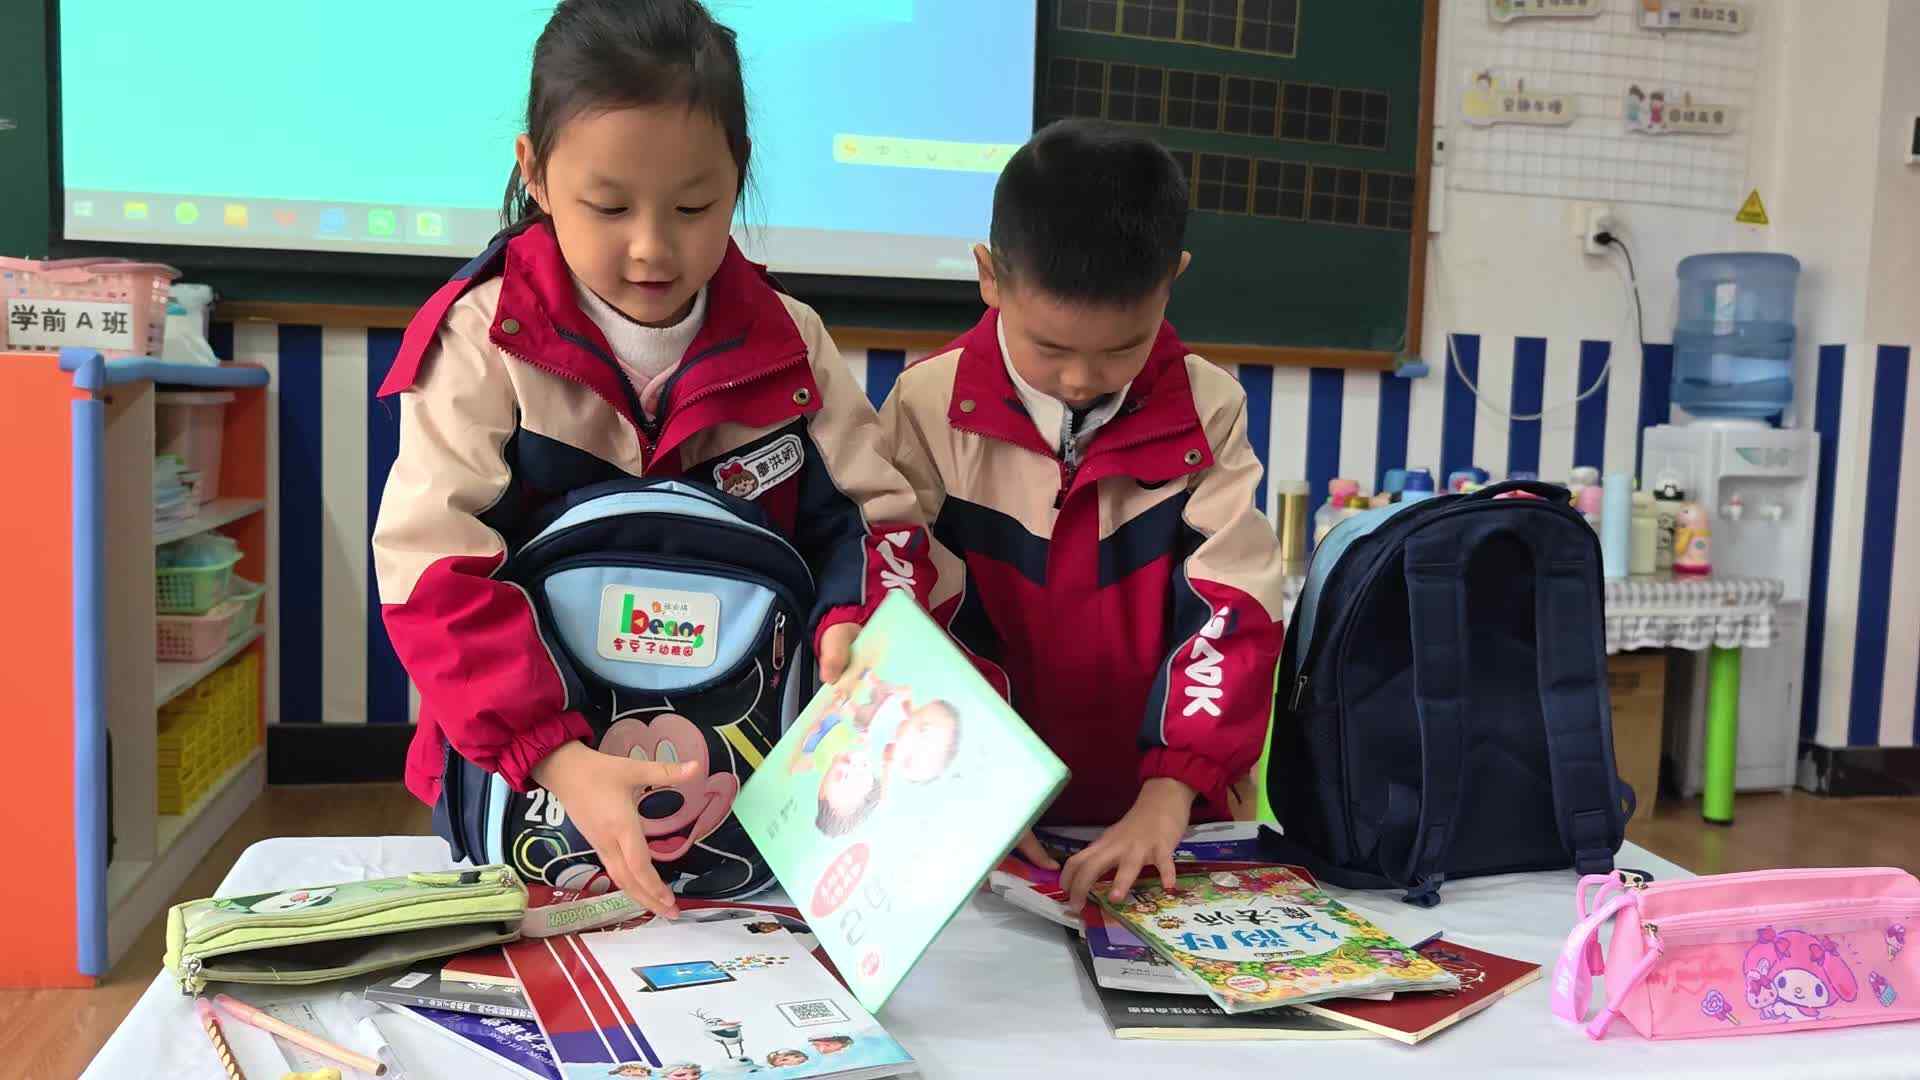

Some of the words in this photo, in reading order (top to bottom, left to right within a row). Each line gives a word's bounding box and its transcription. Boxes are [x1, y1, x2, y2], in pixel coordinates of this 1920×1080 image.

[11, 304, 66, 333] 学前
[76, 311, 93, 329] A
[101, 310, 129, 334] 班
[524, 788, 565, 827] 28
